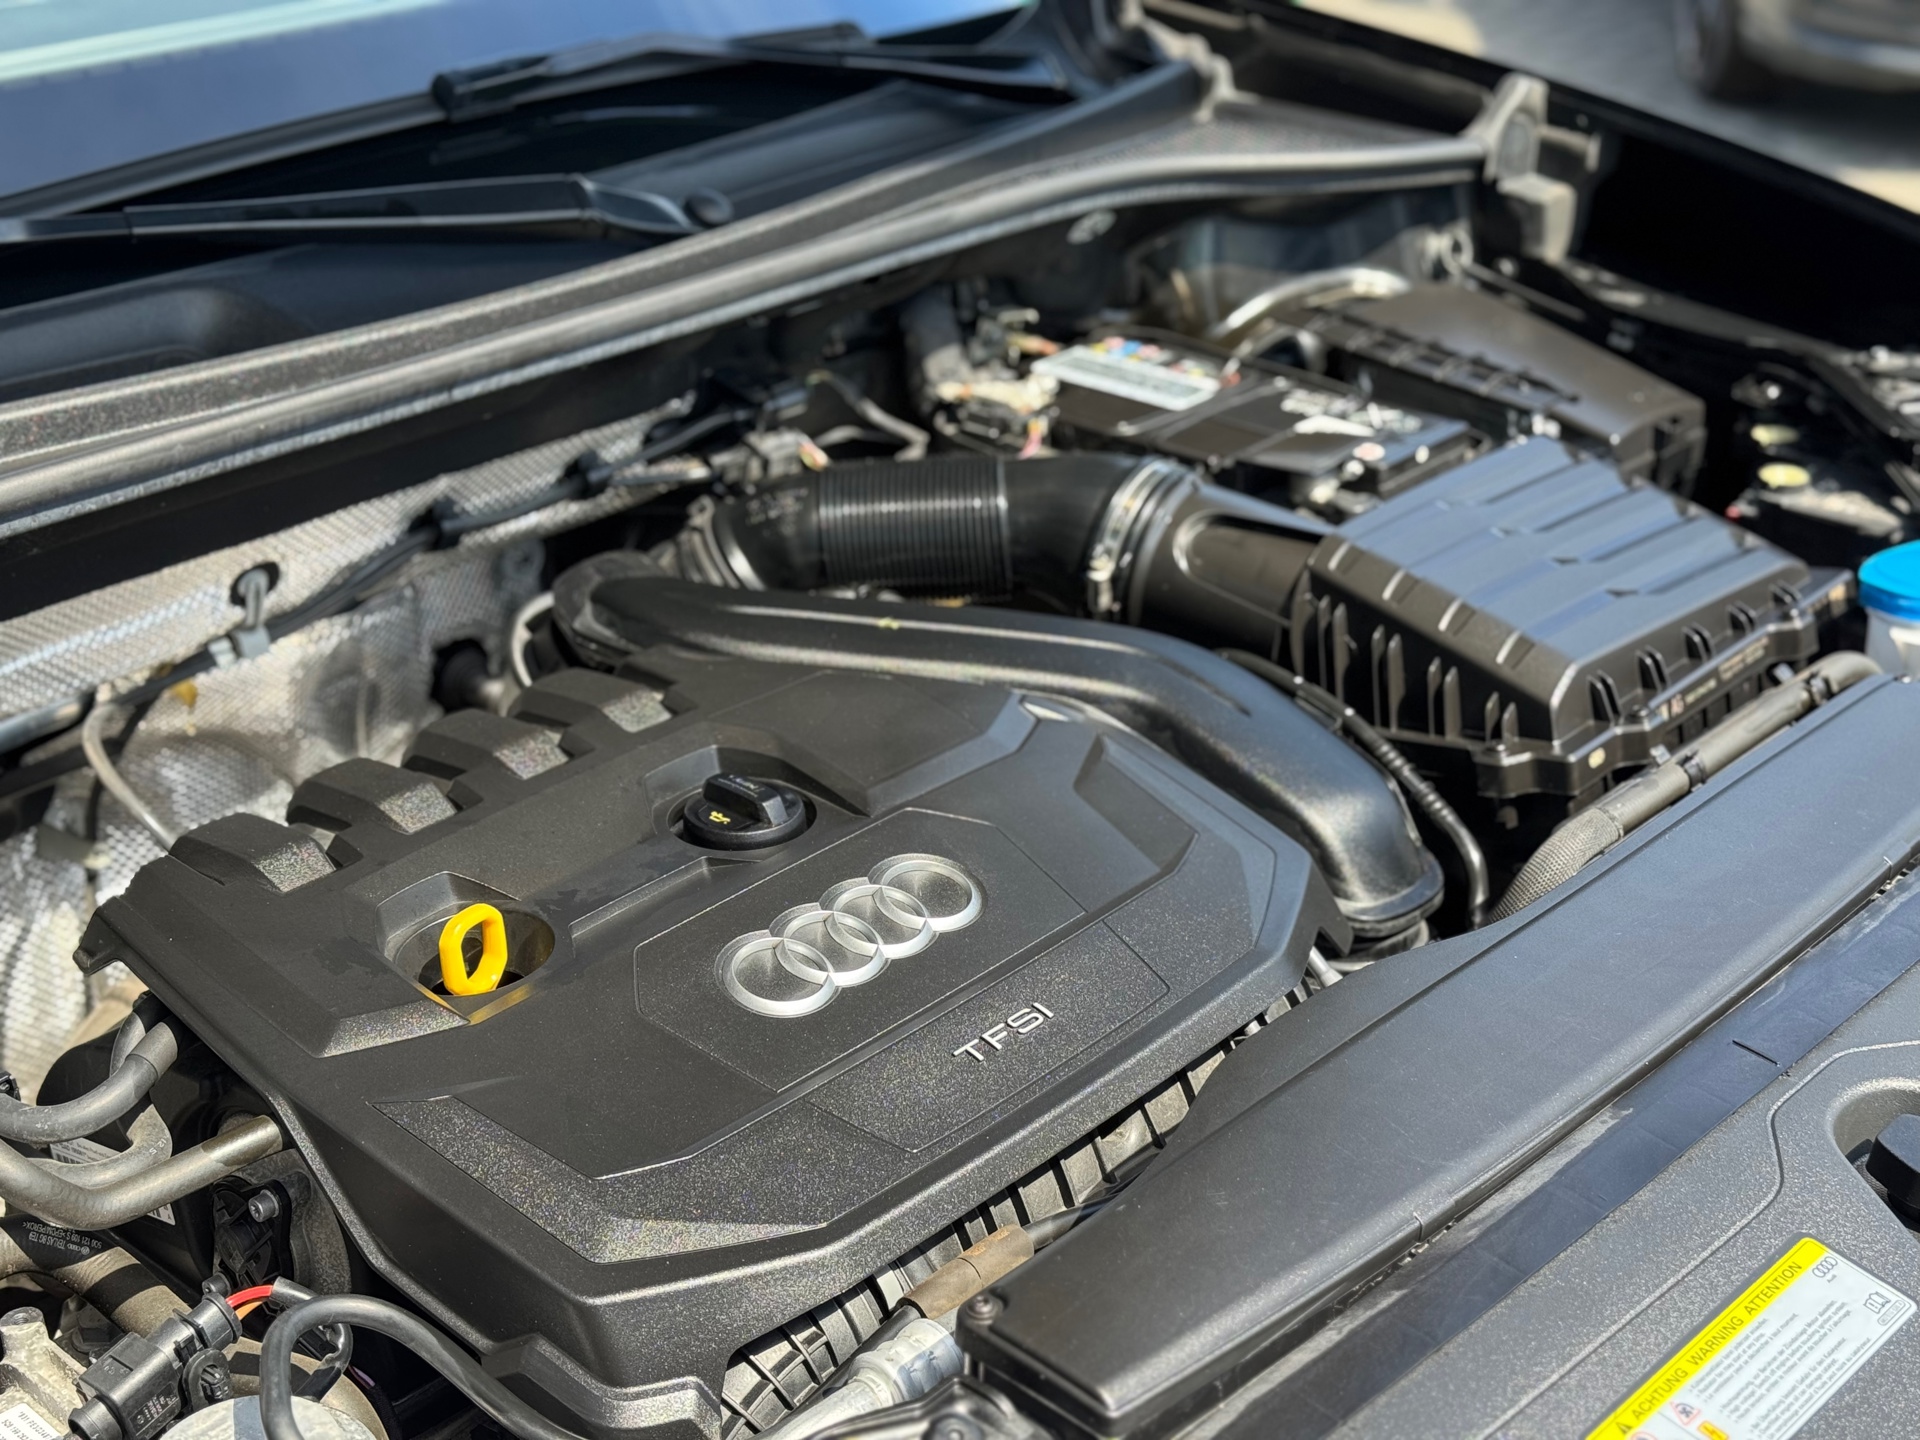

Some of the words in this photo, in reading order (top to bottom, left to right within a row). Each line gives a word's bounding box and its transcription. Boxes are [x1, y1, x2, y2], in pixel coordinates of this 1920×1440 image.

[952, 1002, 1054, 1061] TFSI
[1631, 1367, 1689, 1421] ACHTUNG
[1686, 1315, 1744, 1367] WARNING
[1742, 1261, 1803, 1316] ATTENTION
